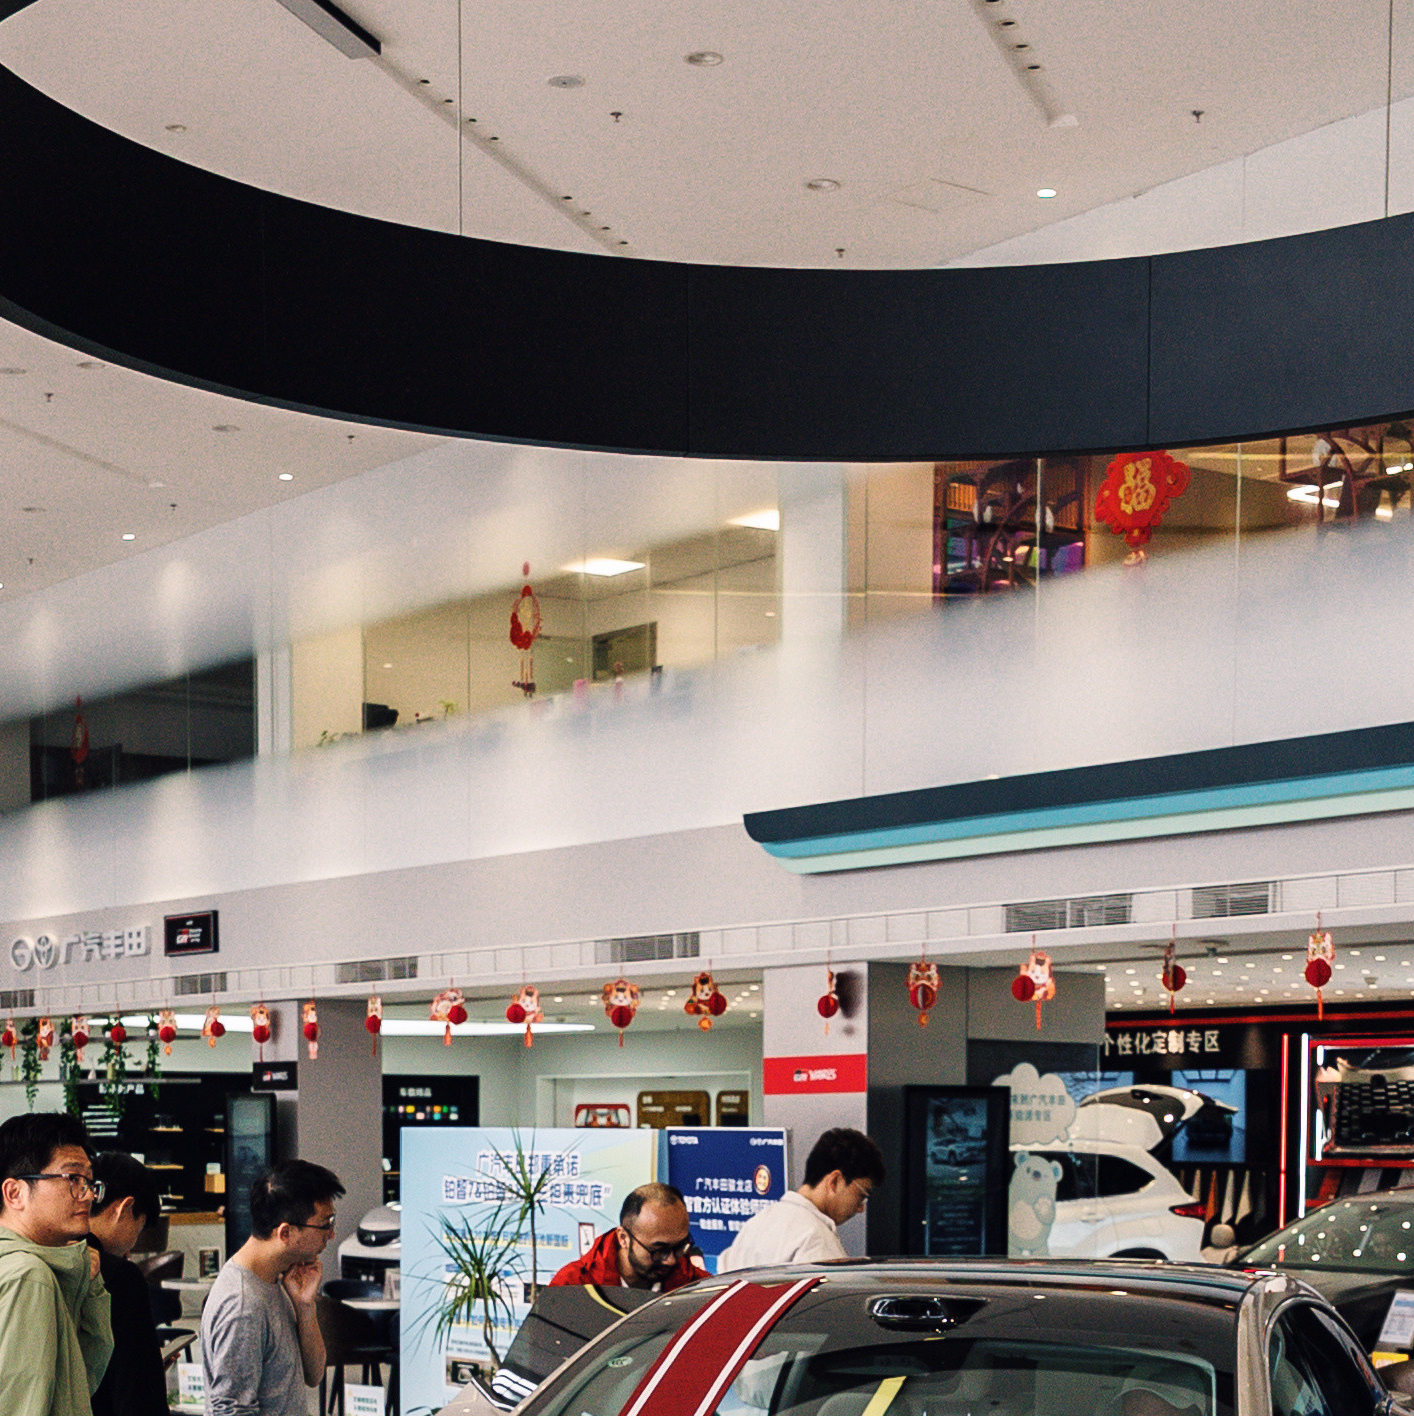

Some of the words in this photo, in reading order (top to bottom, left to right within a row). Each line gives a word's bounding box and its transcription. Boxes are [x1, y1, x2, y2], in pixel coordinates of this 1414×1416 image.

[60, 926, 150, 965] 广汽丰田
[1101, 1030, 1220, 1056] 个性化定制专区
